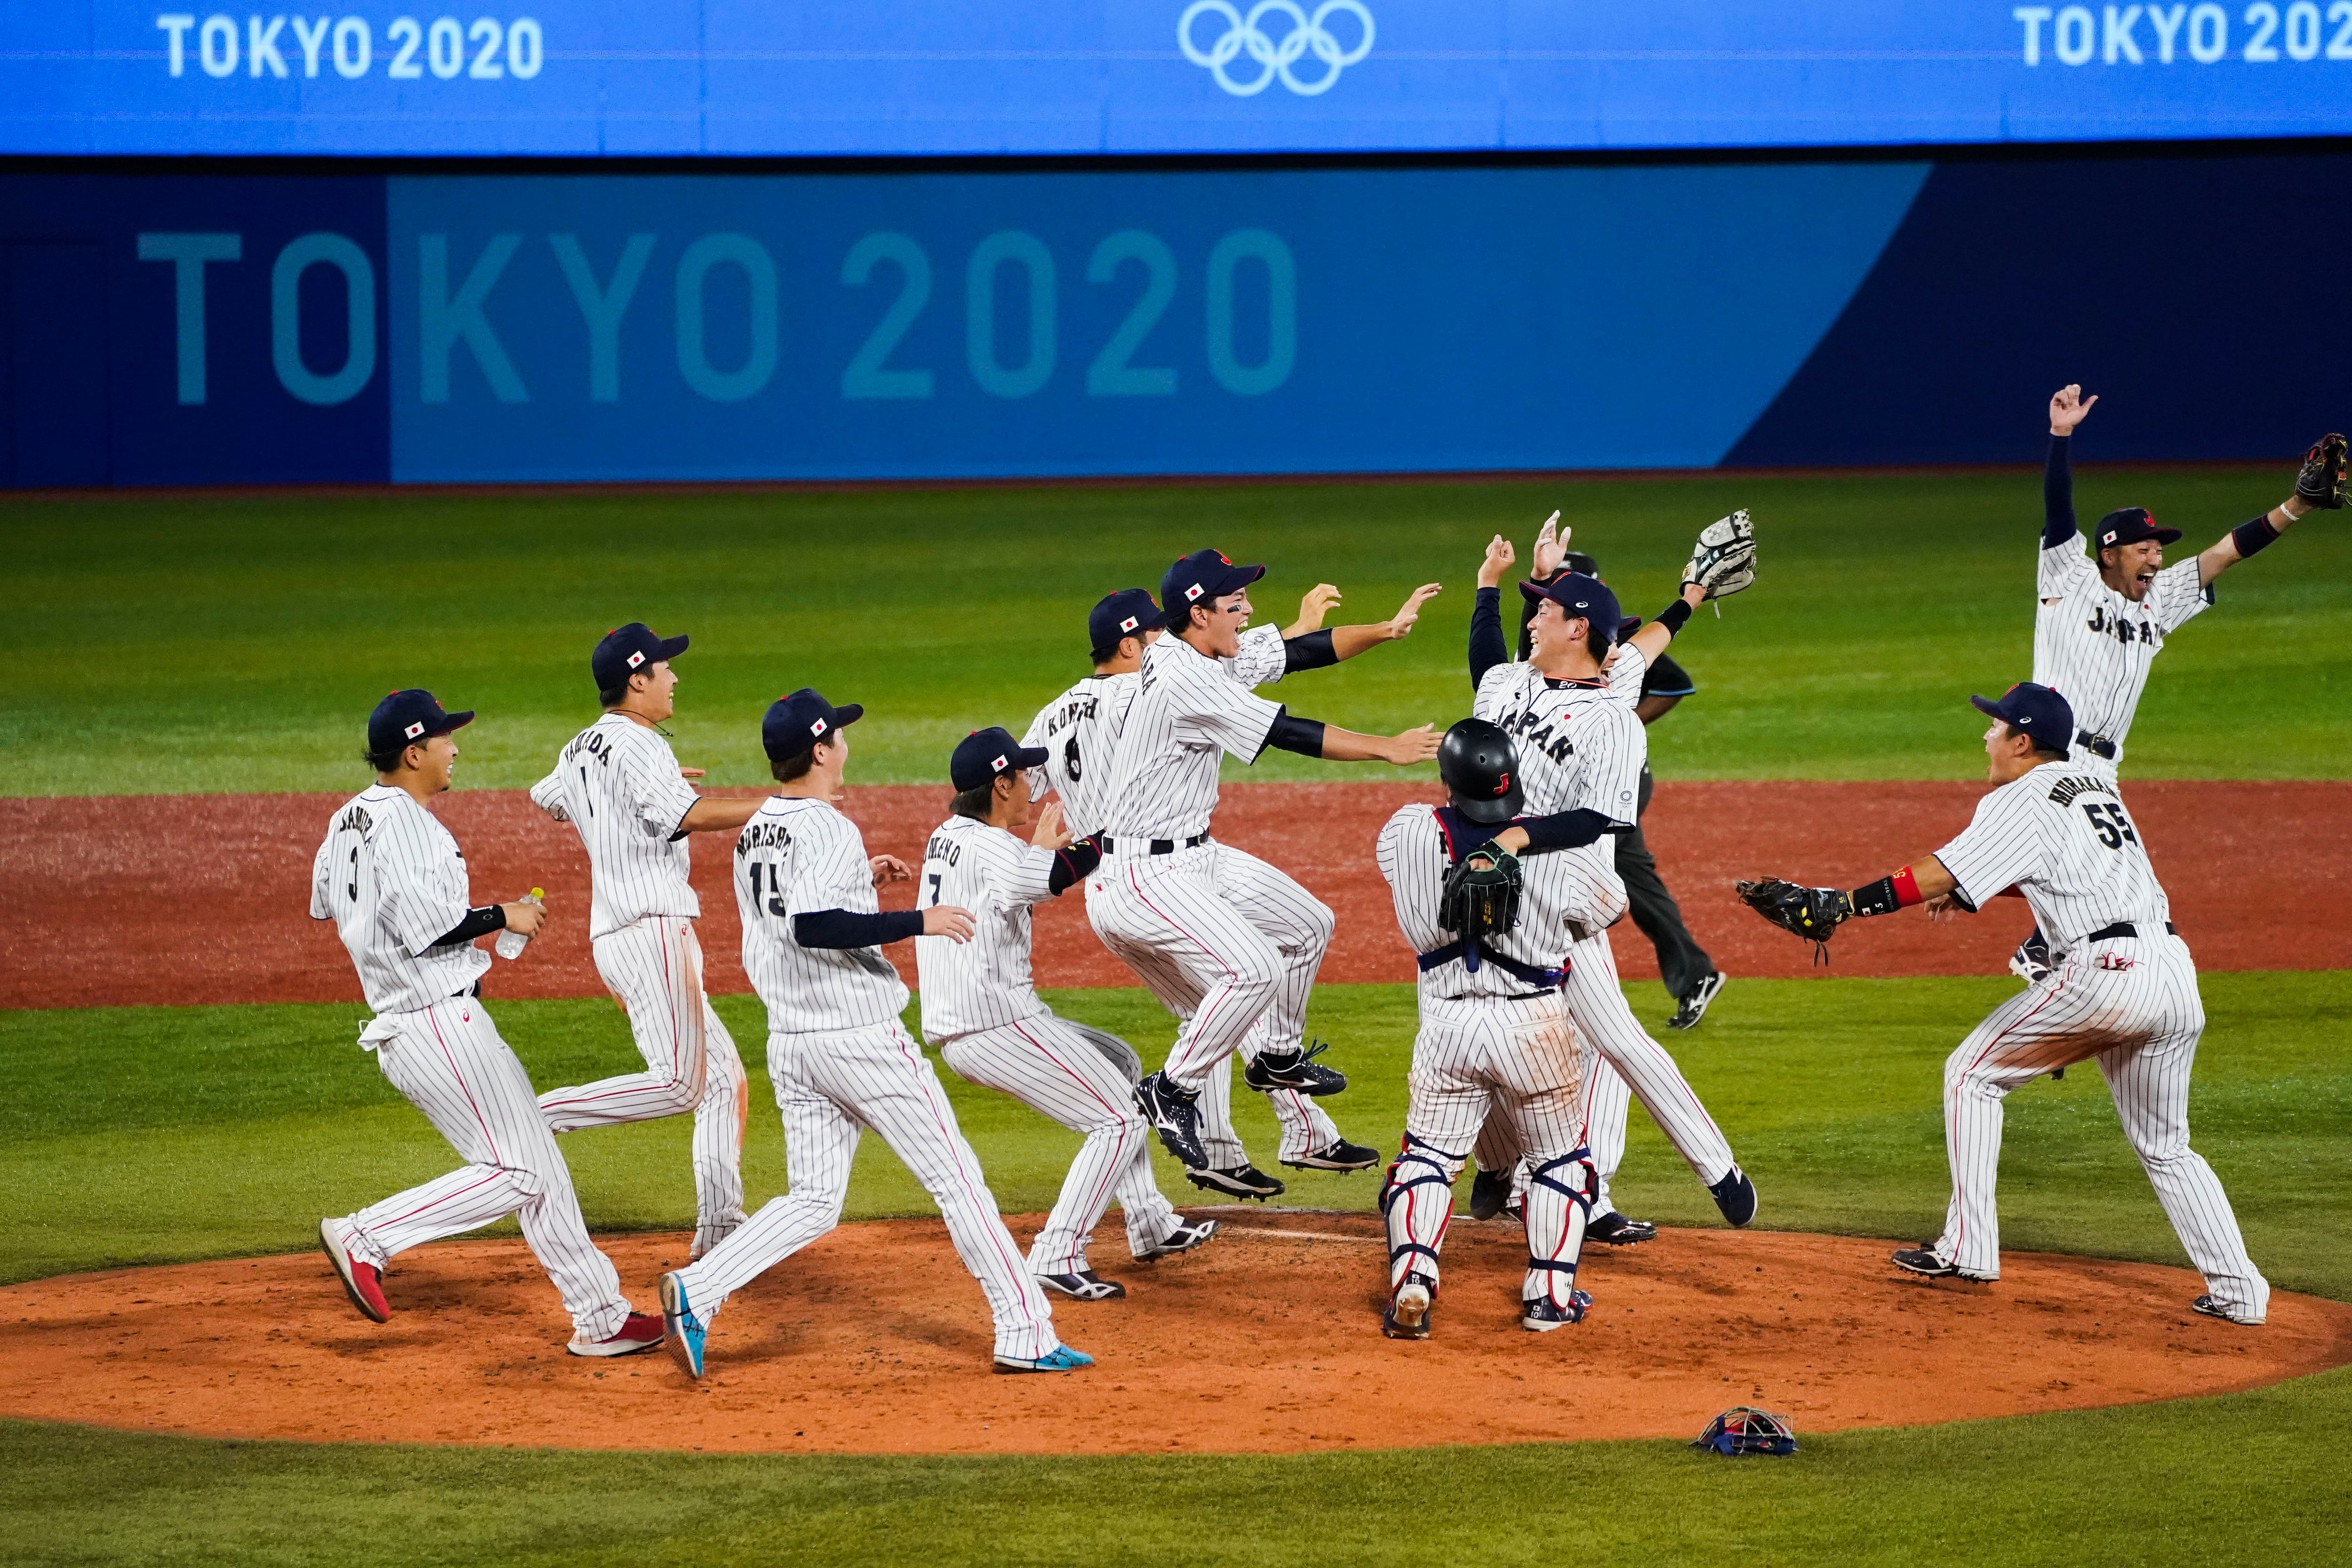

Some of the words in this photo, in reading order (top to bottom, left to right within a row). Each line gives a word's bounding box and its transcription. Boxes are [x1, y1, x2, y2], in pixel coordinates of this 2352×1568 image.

[157, 15, 373, 79] TOKYO
[388, 16, 543, 79] 2020
[2014, 3, 2228, 66] TOKYO
[136, 231, 779, 406] TOKYO
[839, 229, 1297, 400] 2020
[564, 731, 612, 768] YAMADA
[580, 766, 594, 818] 1
[1493, 773, 1509, 795] J
[2082, 803, 2138, 850] 55
[749, 862, 786, 918] 15
[929, 873, 941, 907] 7
